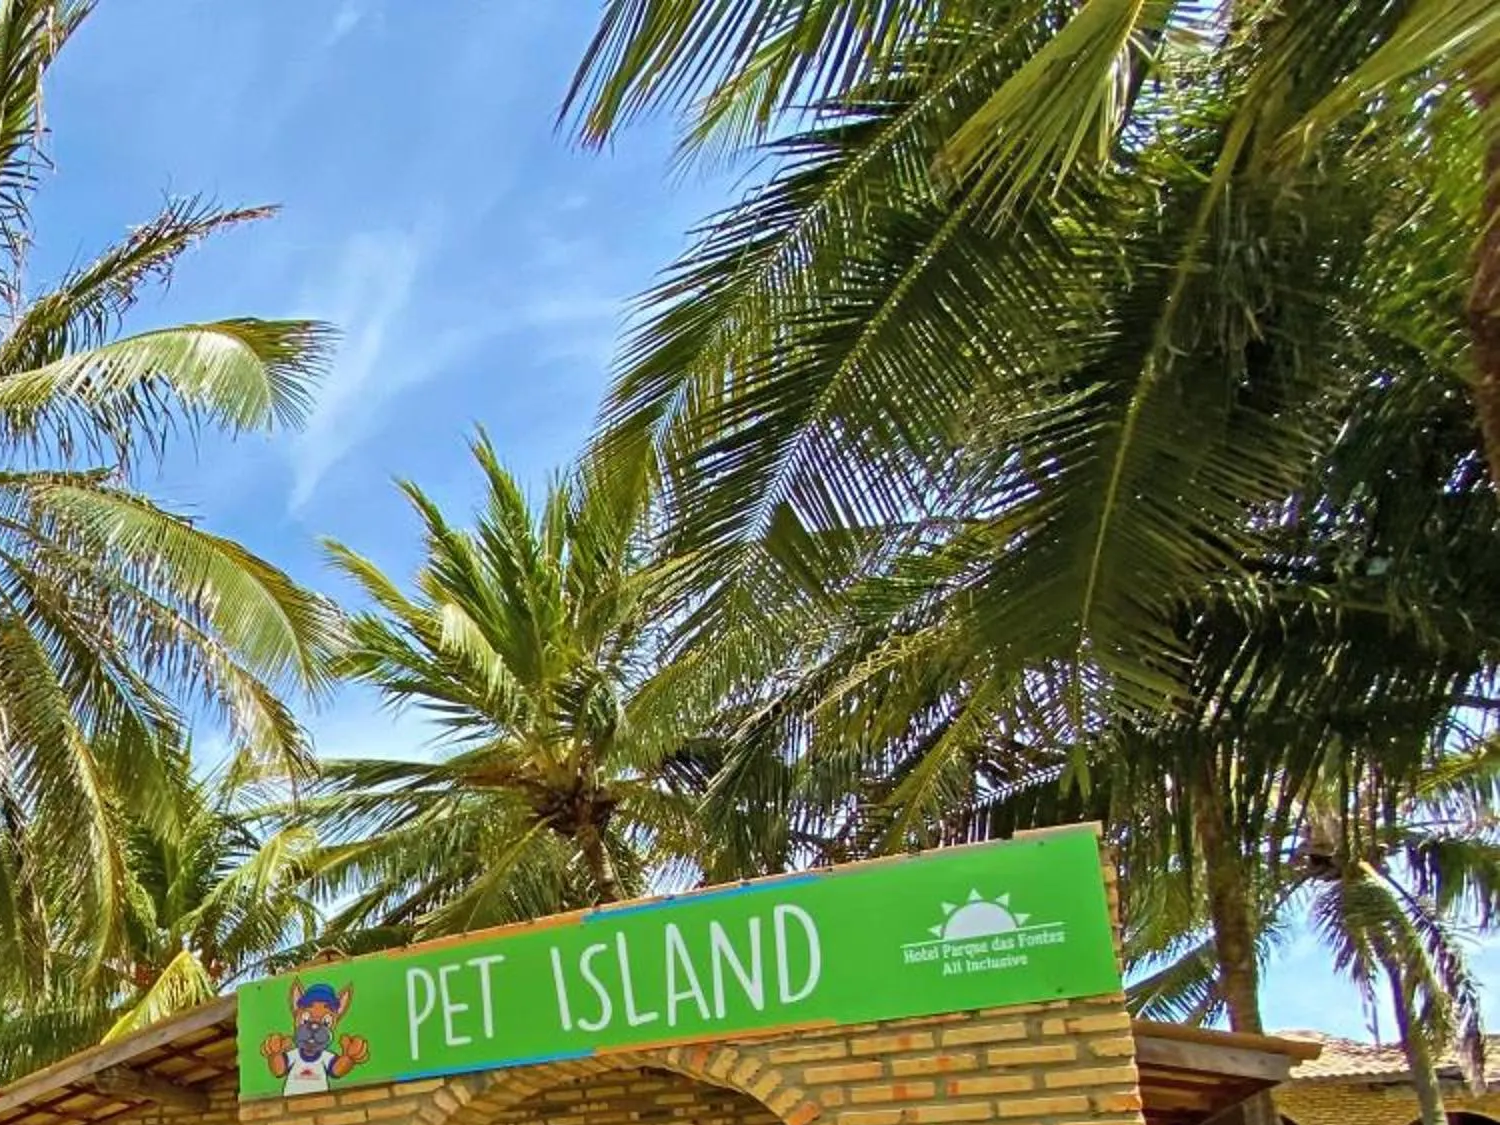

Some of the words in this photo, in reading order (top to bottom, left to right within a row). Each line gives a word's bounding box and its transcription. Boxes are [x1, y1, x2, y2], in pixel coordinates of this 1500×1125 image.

[903, 946, 939, 964] Hotel
[942, 940, 989, 960] Parque
[991, 935, 1016, 952] das
[1017, 929, 1066, 948] Fontes
[406, 954, 506, 1061] PET
[550, 903, 821, 1032] ISLAND
[942, 960, 963, 977] All
[966, 953, 1029, 974] Inclusive
